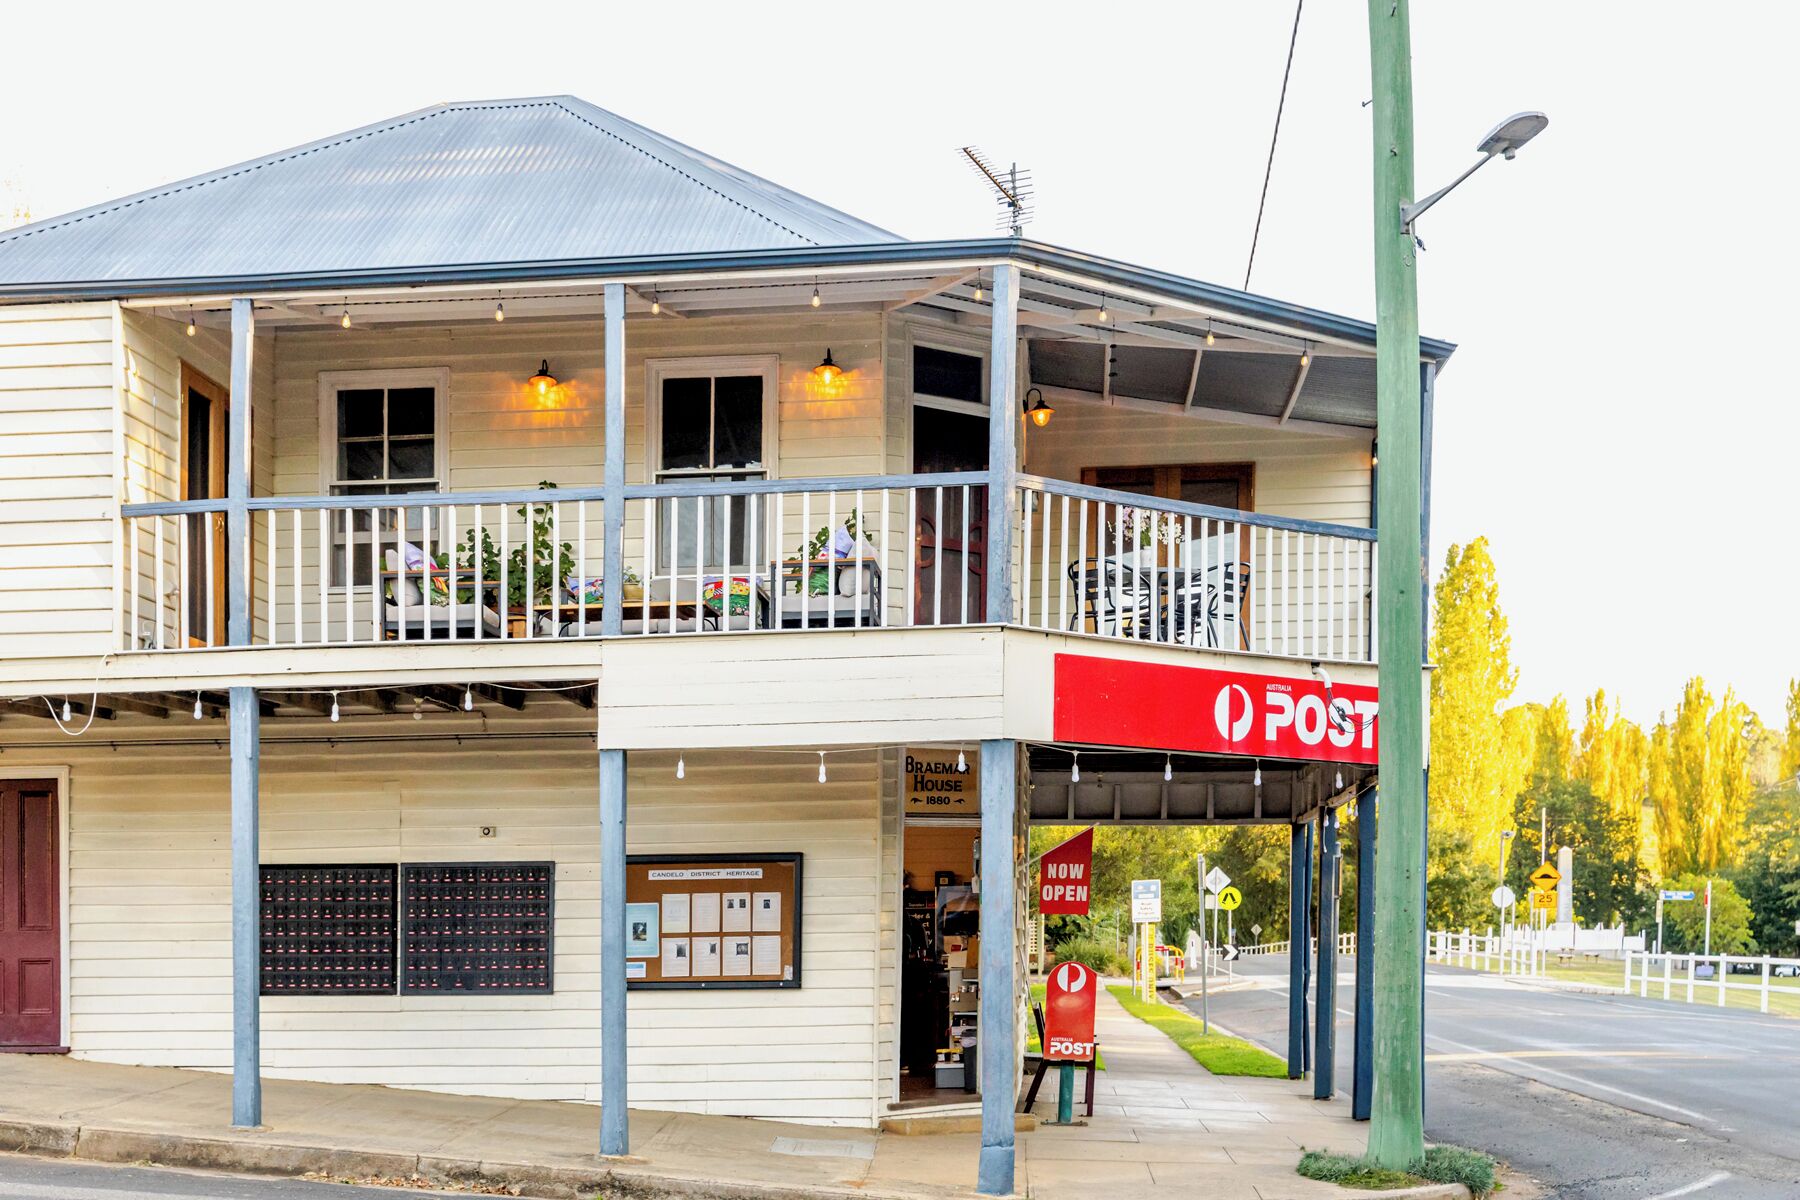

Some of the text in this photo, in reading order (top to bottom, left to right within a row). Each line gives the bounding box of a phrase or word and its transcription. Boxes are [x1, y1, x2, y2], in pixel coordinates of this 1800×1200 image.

[1266, 683, 1292, 692] AUSTRALIA
[1265, 691, 1379, 749] POST
[913, 774, 962, 792] HOUSE
[926, 796, 951, 805] 1880
[1047, 863, 1084, 880] NOW
[1042, 884, 1088, 902] OPEN
[1538, 894, 1553, 903] 25
[1050, 1042, 1094, 1055] POST
